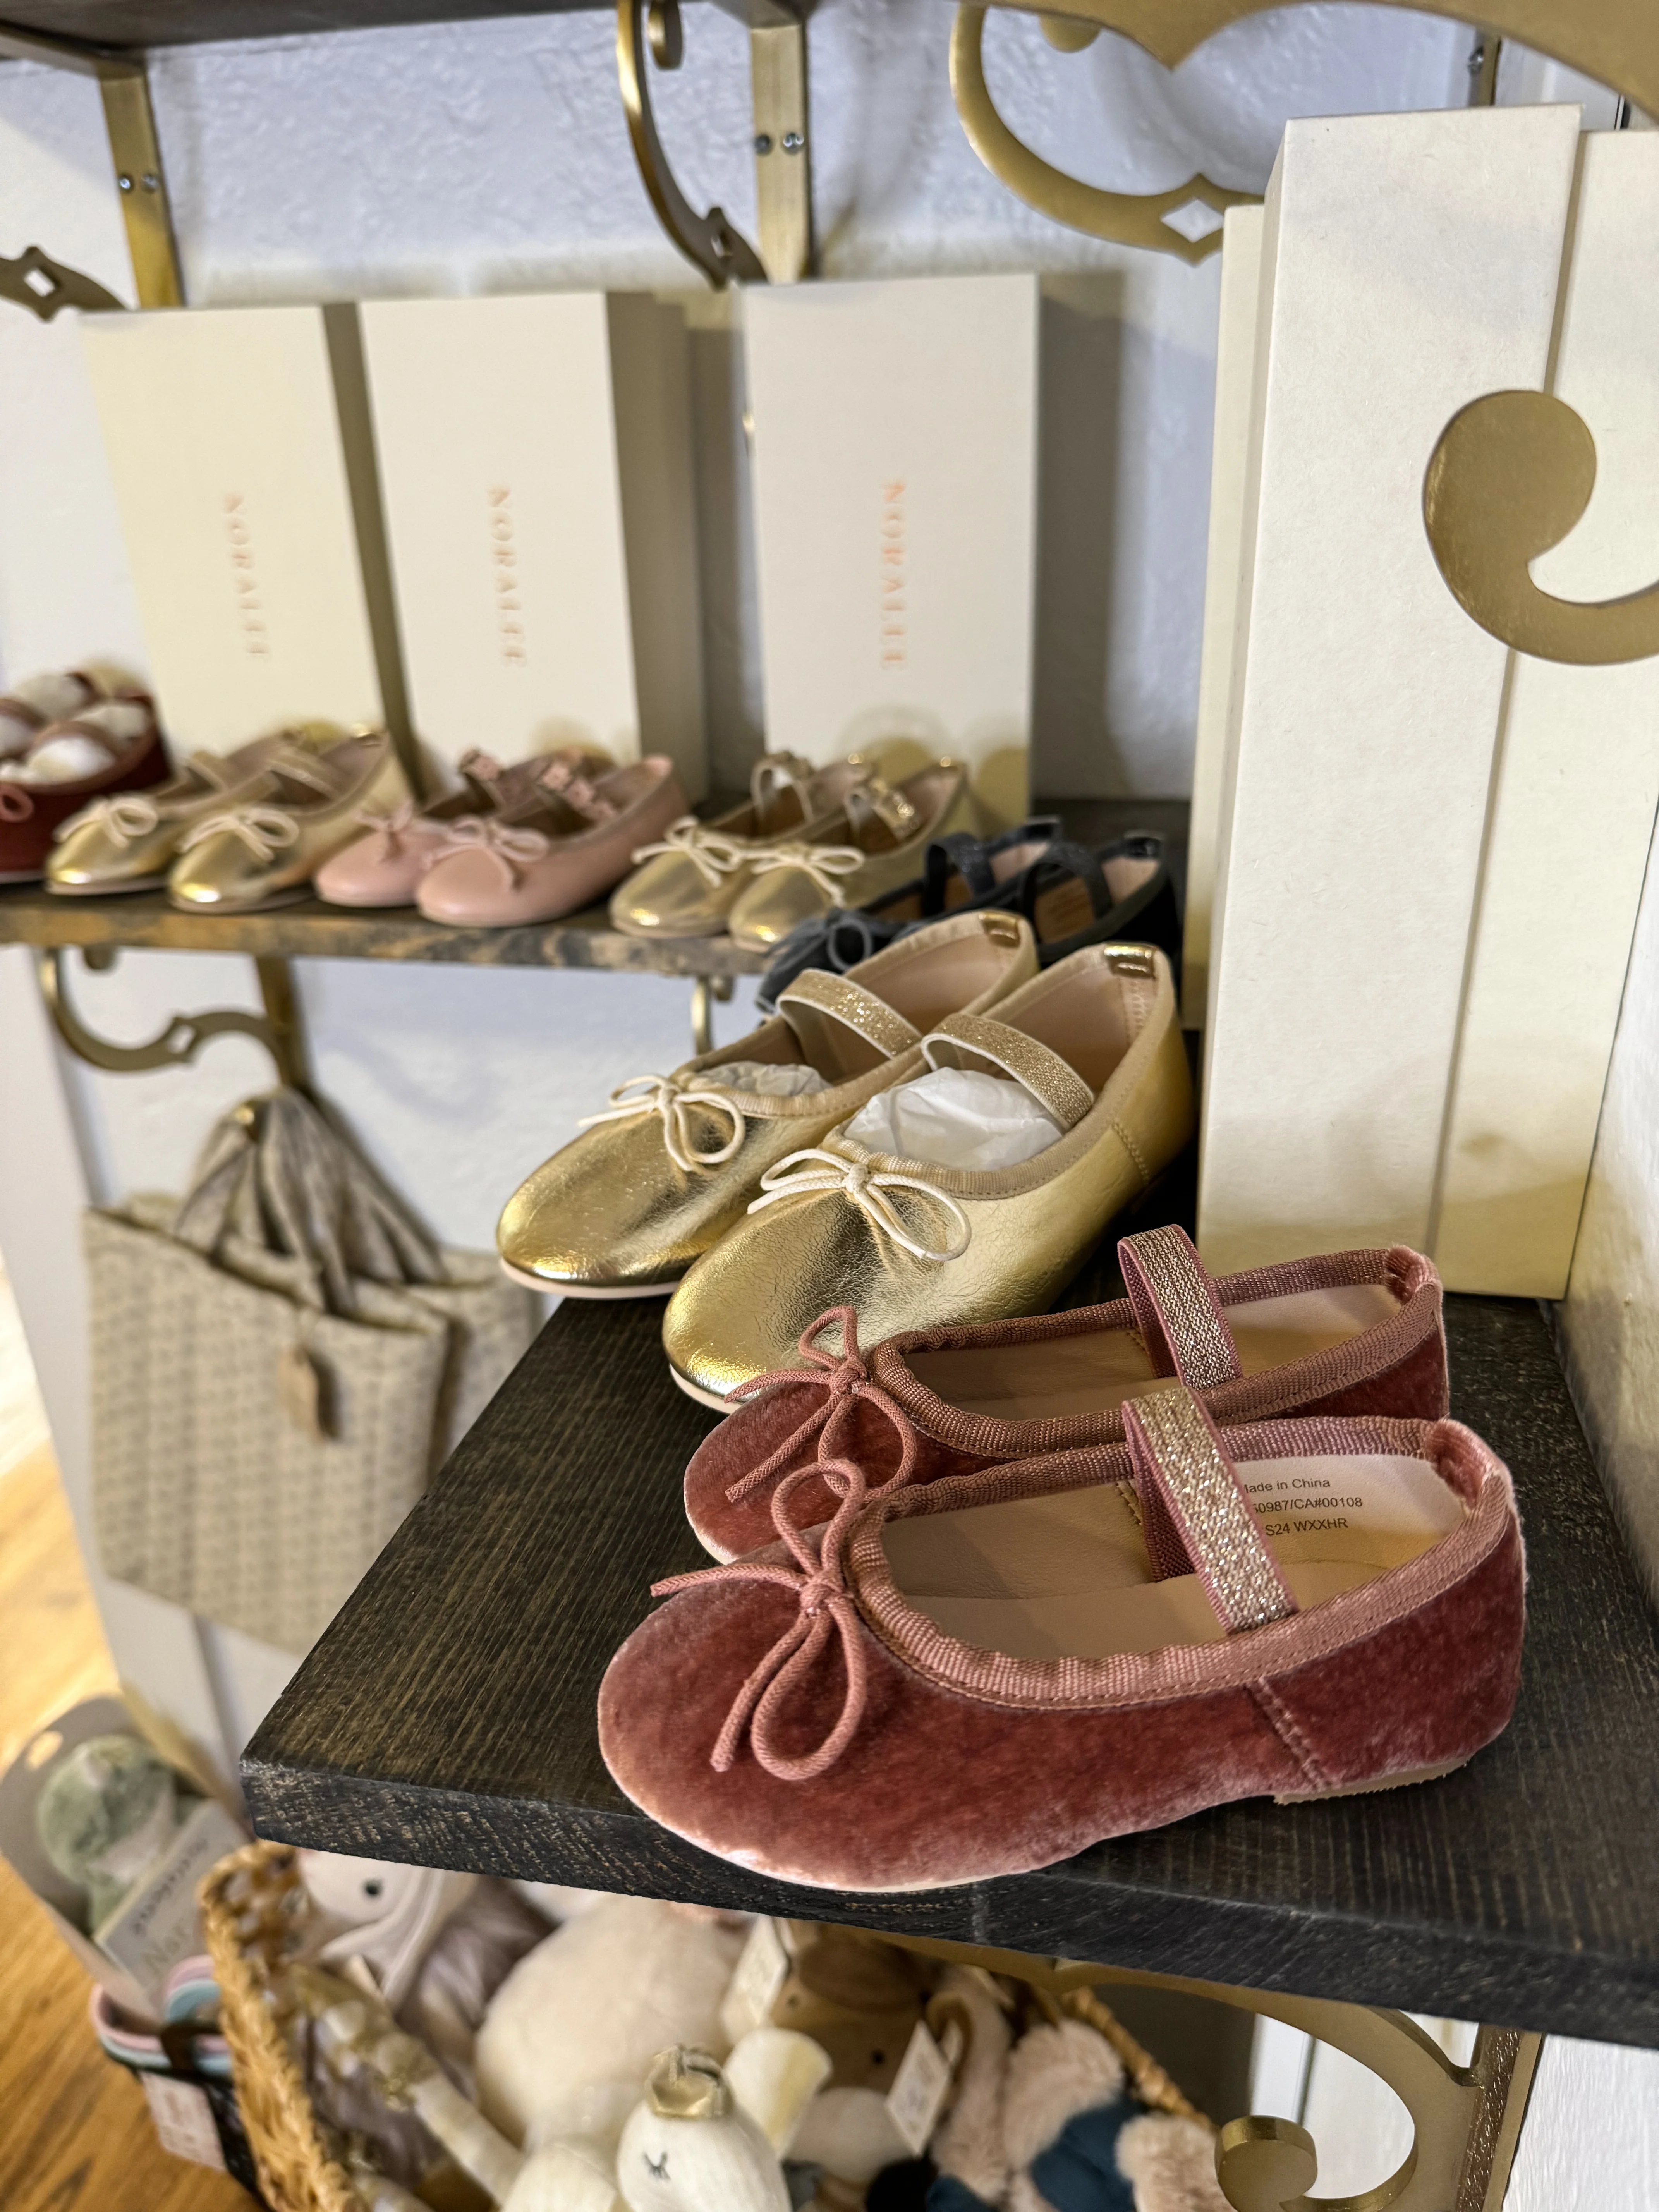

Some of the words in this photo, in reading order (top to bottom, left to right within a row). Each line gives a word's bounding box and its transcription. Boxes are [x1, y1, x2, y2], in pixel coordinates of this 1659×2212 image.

[881, 478, 908, 670] NORALEE
[1277, 1480, 1288, 1490] in
[1292, 1478, 1331, 1489] China
[1265, 1522, 1290, 1536] S24
[1293, 1517, 1348, 1532] WXXHR
